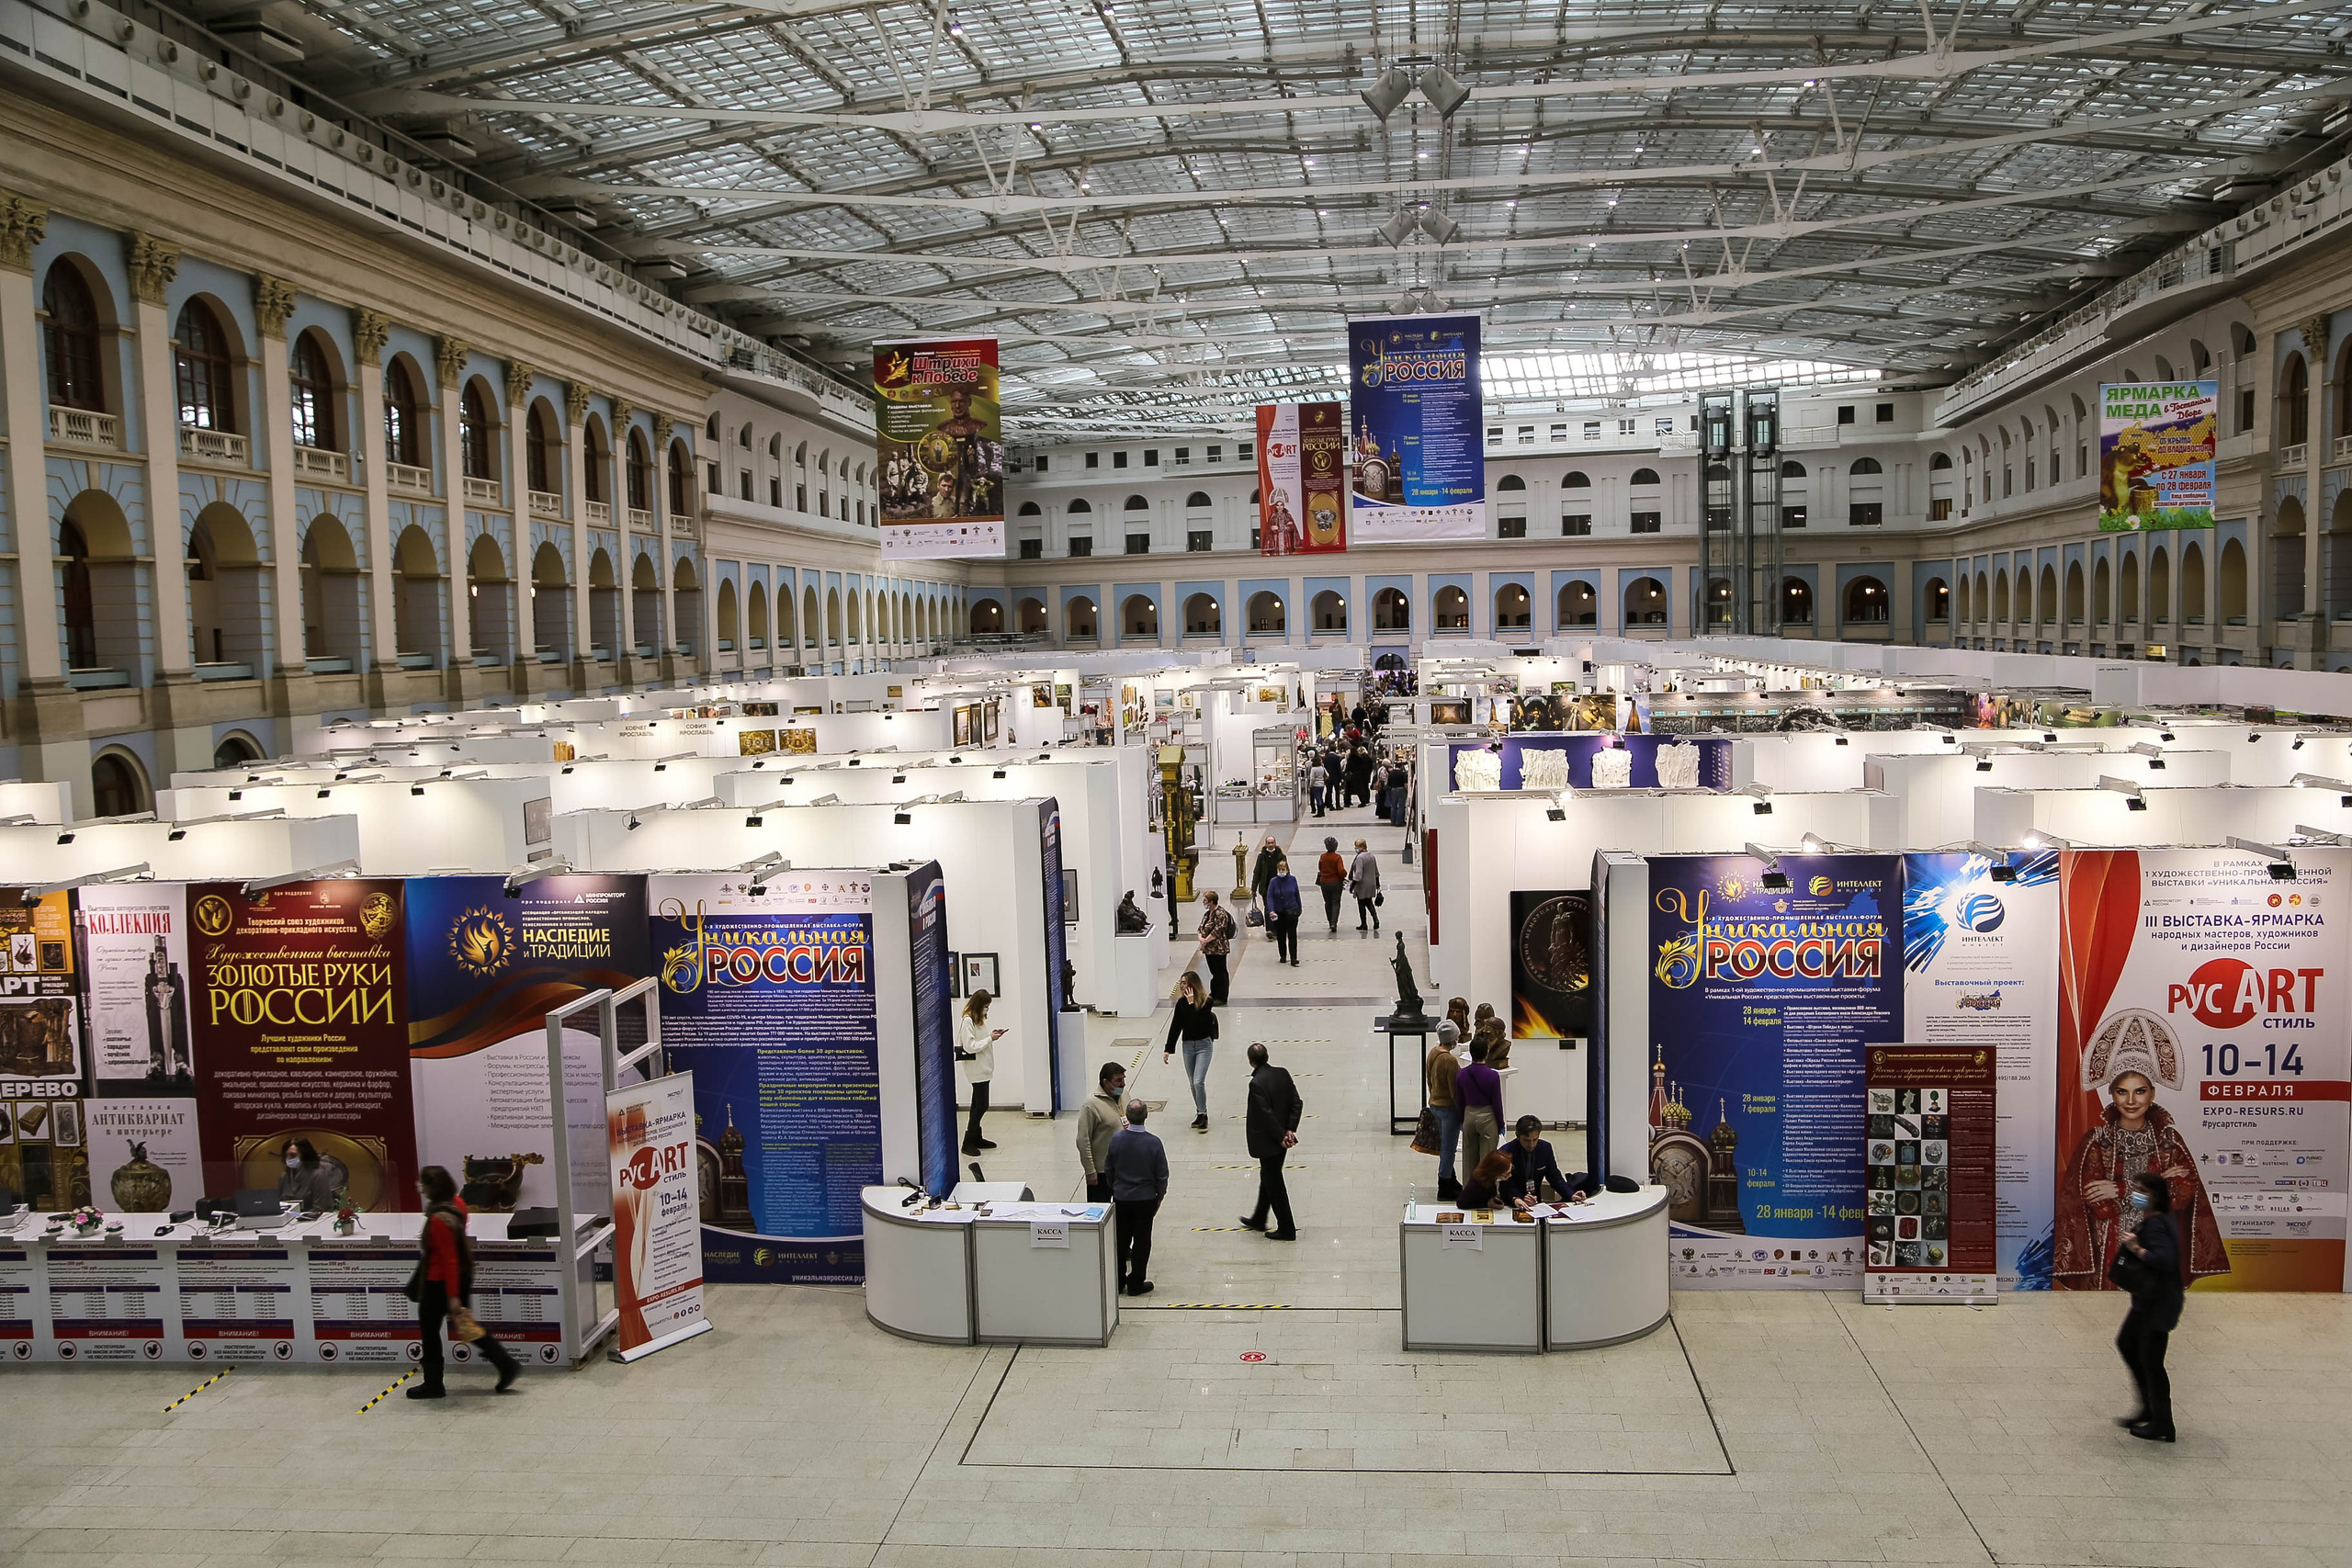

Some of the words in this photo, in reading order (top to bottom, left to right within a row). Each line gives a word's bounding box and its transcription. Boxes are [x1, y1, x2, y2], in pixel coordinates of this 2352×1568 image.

[913, 357, 980, 371] Штрихи
[911, 374, 921, 384] к
[922, 369, 978, 384] Победе
[1385, 360, 1465, 381] РОССИЯ
[2106, 385, 2200, 400] ЯРМАРКА
[2107, 404, 2162, 419] МЕДА
[1303, 443, 1340, 451] РОССИИ
[2167, 444, 2212, 453] ВЛАДИВОСТОКА
[2167, 470, 2177, 479] 27
[2179, 470, 2207, 480] января
[2167, 482, 2177, 491] 28
[2178, 481, 2211, 491] февраля
[89, 913, 172, 935] КОЛЛЕКЦИЯ
[247, 918, 286, 926] Творческий
[305, 918, 345, 926] художников
[2145, 916, 2157, 927] III
[2163, 914, 2324, 927] ВЫСТАВКА-ЯРМАРКА
[235, 927, 323, 935] декоративно-прикладного
[523, 929, 610, 943] НАСЛЕДИЕ
[2151, 931, 2200, 940] народных
[2256, 930, 2318, 939] художников
[1656, 887, 1888, 989] Уникальная
[659, 897, 869, 994] Уникальная
[2190, 942, 2251, 952] дизайнеров
[2255, 941, 2290, 950] России
[205, 943, 323, 964] Художественная
[326, 944, 391, 959] выставка
[530, 944, 611, 960] ТРАДИЦИИ
[707, 945, 865, 984] РОССИЯ
[1705, 939, 1882, 978] РОССИЯ
[207, 964, 320, 987] ЗОЛОТЫЕ
[324, 964, 392, 986] РУКИ
[209, 988, 395, 1025] РОССИИ
[1964, 999, 2001, 1009] РОССИЯ
[1743, 1006, 1752, 1015] 28
[1753, 1007, 1776, 1016] января
[1743, 1017, 1752, 1025] 14
[1753, 1017, 1781, 1027] февраля
[261, 1034, 287, 1043] Лучшие
[288, 1034, 322, 1043] художники
[323, 1033, 346, 1042] России
[251, 1045, 295, 1054] представляют
[313, 1045, 358, 1054] произведения
[0, 1082, 78, 1097] ЕРЕВО
[2208, 1085, 2293, 1096] ФЕВРАЛЯ
[1742, 1094, 1751, 1103] 28
[1752, 1094, 1776, 1104] января
[1747, 1104, 1776, 1115] февраля
[2203, 1108, 2304, 1116] EXPO-RESURS.RU
[93, 1113, 185, 1125] АНТИКВАРИАТ
[616, 1111, 685, 1136] ВЫСТАВКА-ЯРМАРКА
[2202, 1120, 2256, 1129] #русартстиль
[118, 1128, 173, 1137] интерьере
[1747, 1179, 1776, 1189] февраля
[661, 1201, 687, 1217] февраля
[1757, 1204, 1771, 1218] 28
[1774, 1205, 1814, 1221] января
[792, 1274, 865, 1282] уникальнаяроссия.рус
[647, 1285, 684, 1303] EXPO-RESURS.RU
